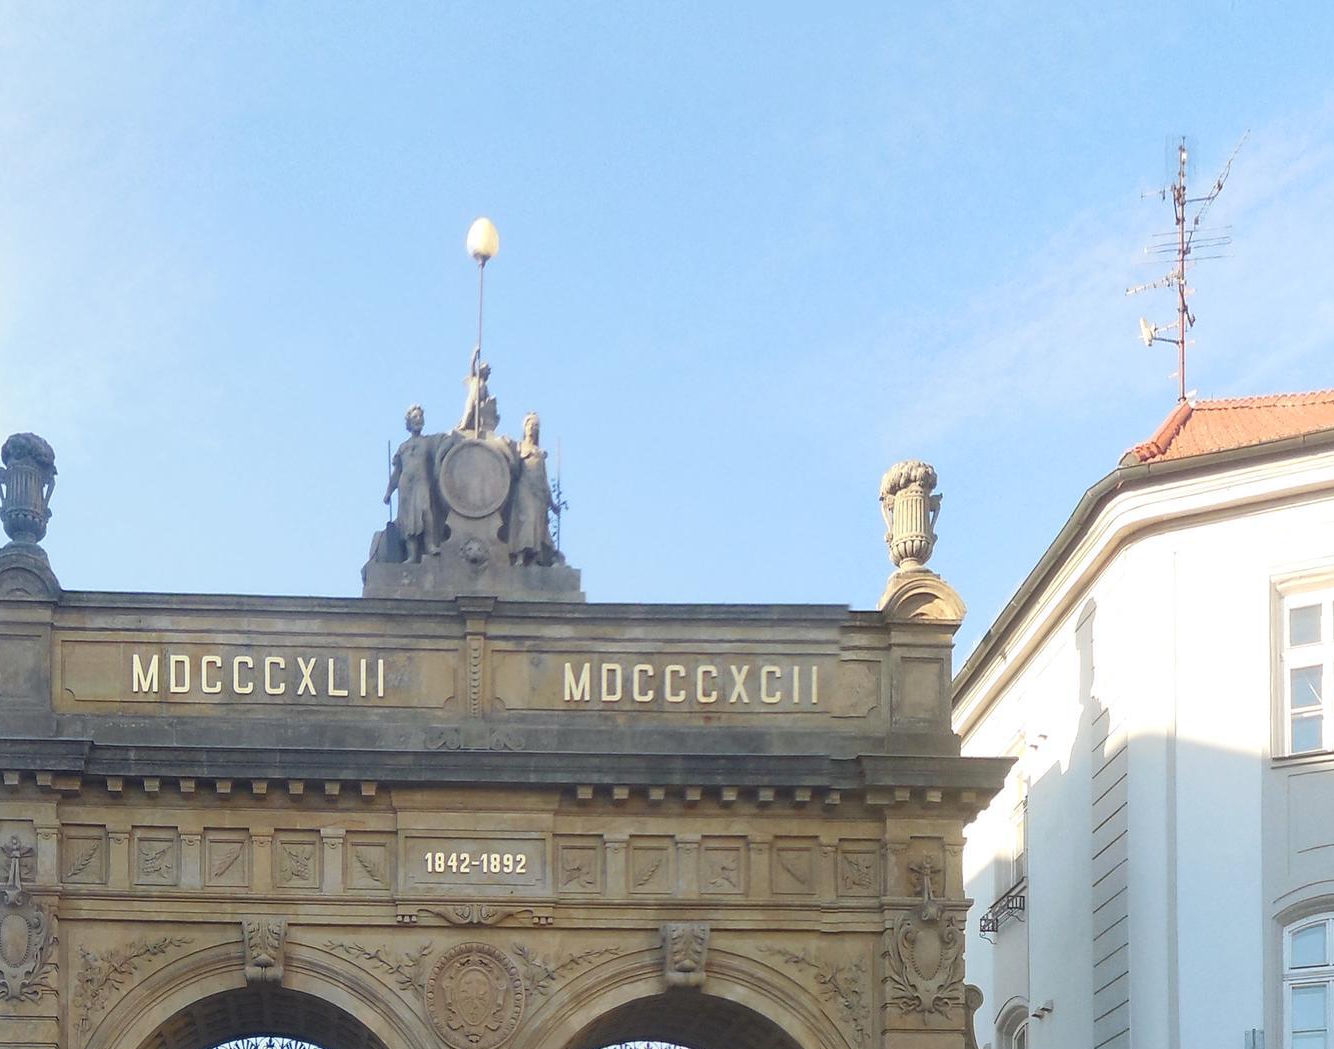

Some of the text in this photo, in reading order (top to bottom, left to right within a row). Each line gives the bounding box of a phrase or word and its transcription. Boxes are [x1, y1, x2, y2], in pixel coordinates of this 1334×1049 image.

[132, 653, 385, 698] MDCCCXLII
[563, 662, 818, 704] MDCCCXCII
[425, 852, 527, 873] 1842-1892
